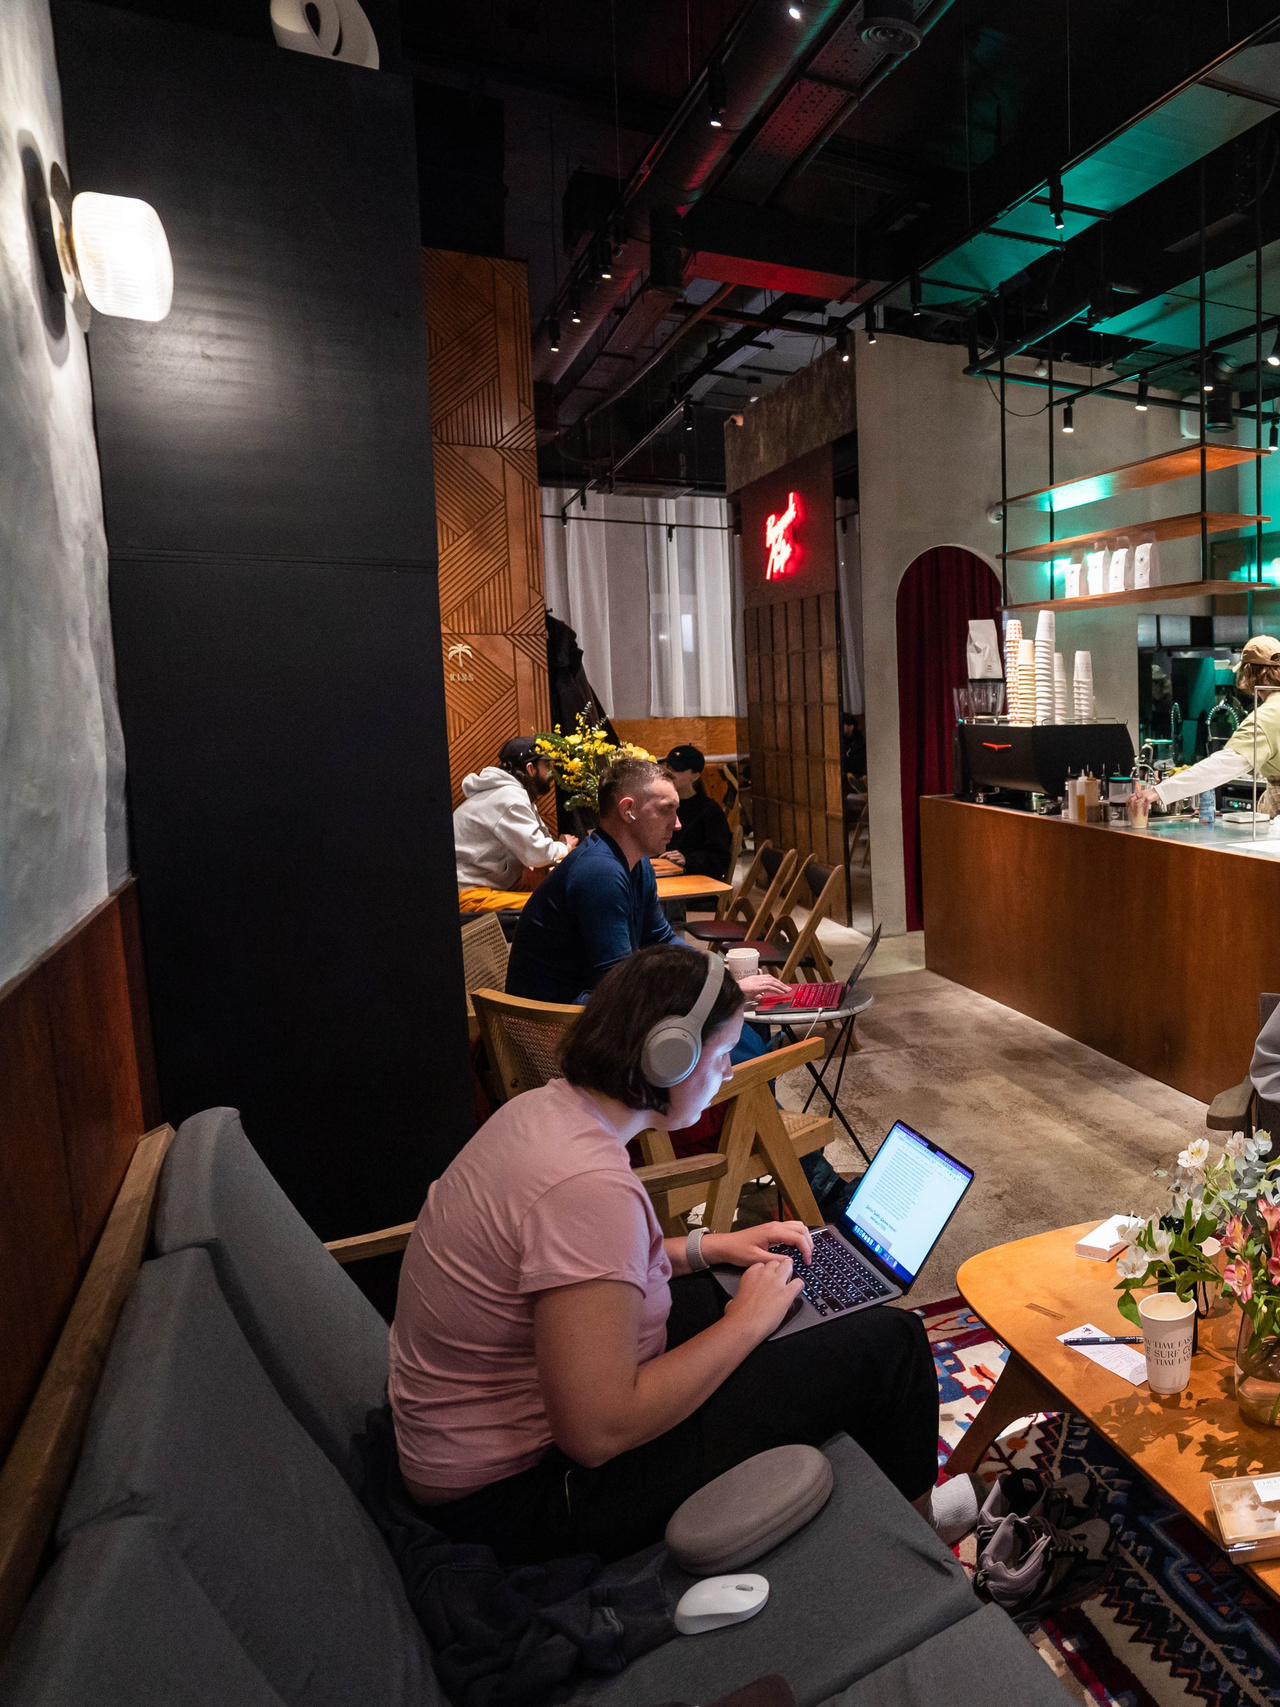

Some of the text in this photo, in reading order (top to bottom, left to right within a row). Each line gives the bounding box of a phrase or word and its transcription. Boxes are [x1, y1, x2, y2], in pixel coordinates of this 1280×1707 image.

[449, 673, 474, 682] KISS
[1153, 1340, 1175, 1349] TIME
[1154, 1349, 1180, 1359] SURF
[1155, 1358, 1175, 1366] TIME
